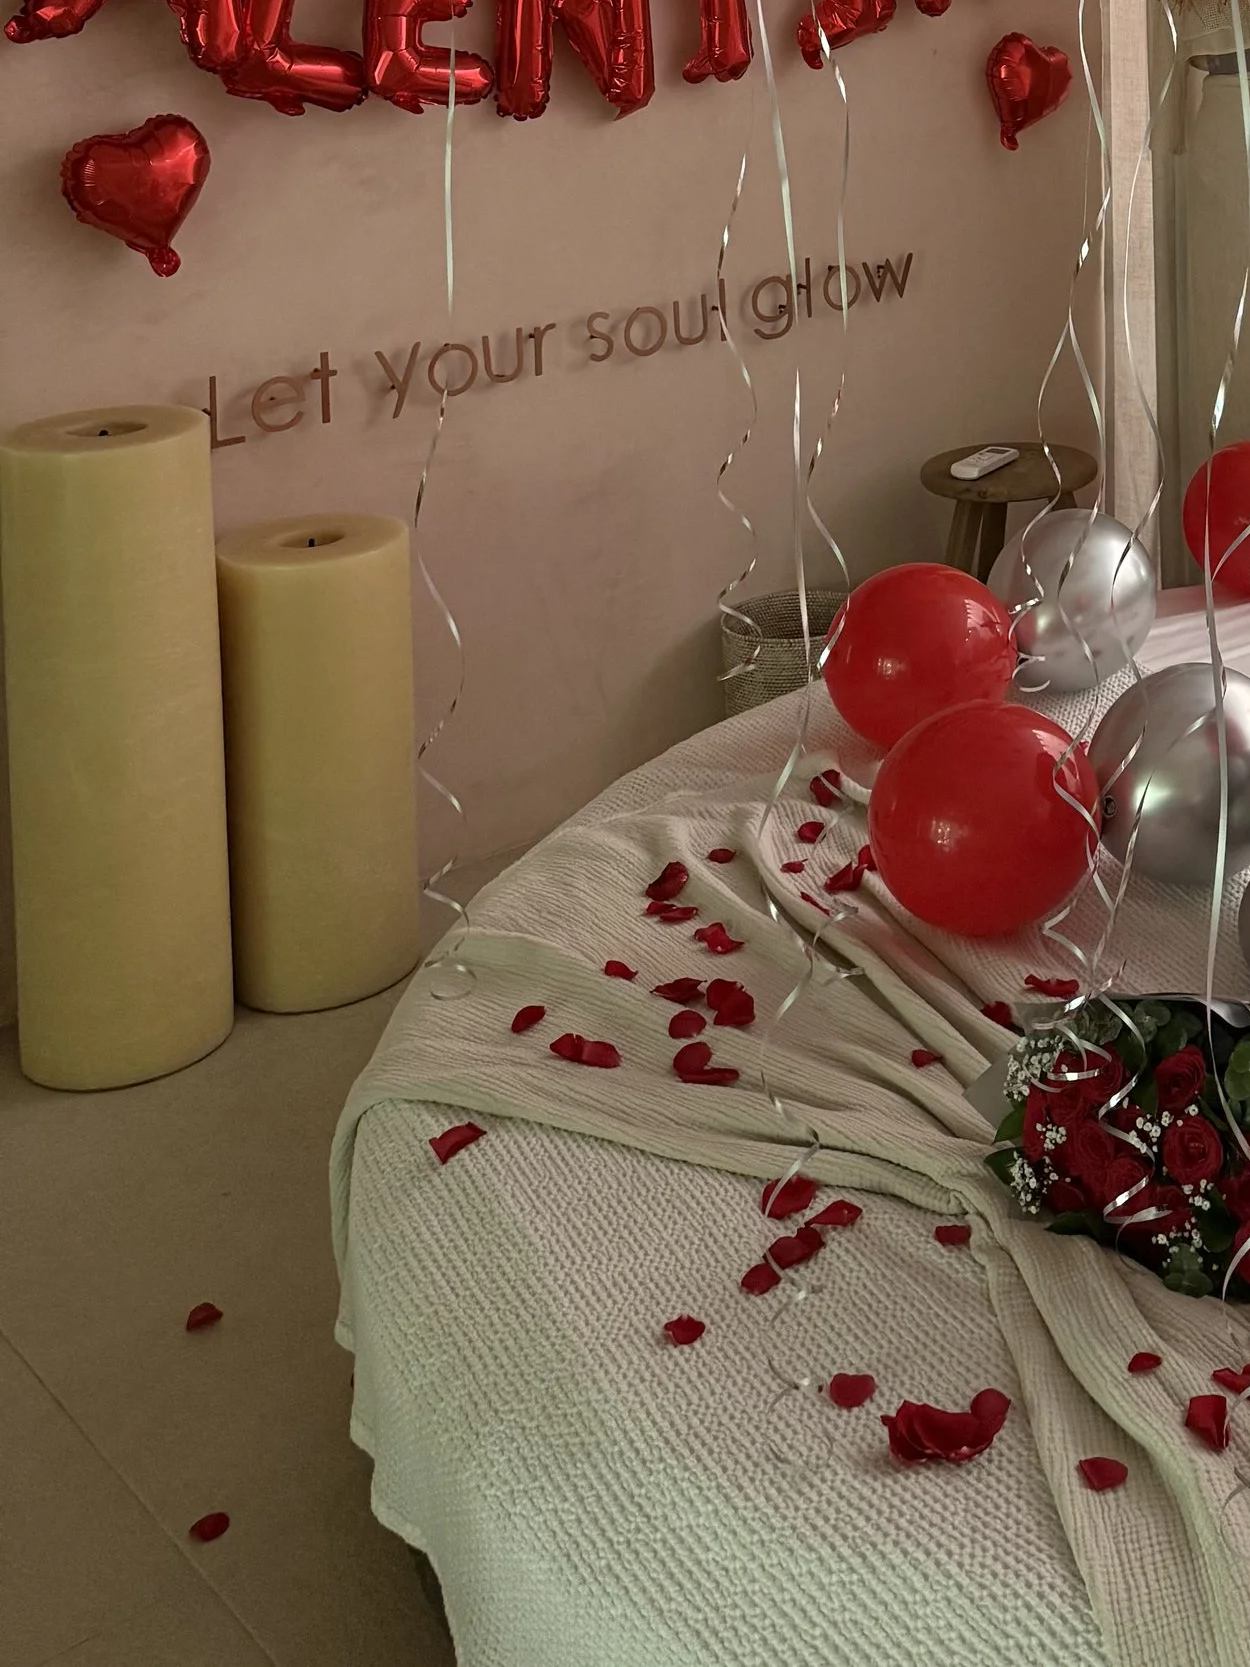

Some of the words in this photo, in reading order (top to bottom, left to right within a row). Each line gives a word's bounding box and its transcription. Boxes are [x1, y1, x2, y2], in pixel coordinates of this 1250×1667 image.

[209, 350, 338, 449] Let
[374, 319, 557, 419] your
[589, 278, 730, 363] soul
[751, 251, 914, 339] glow
